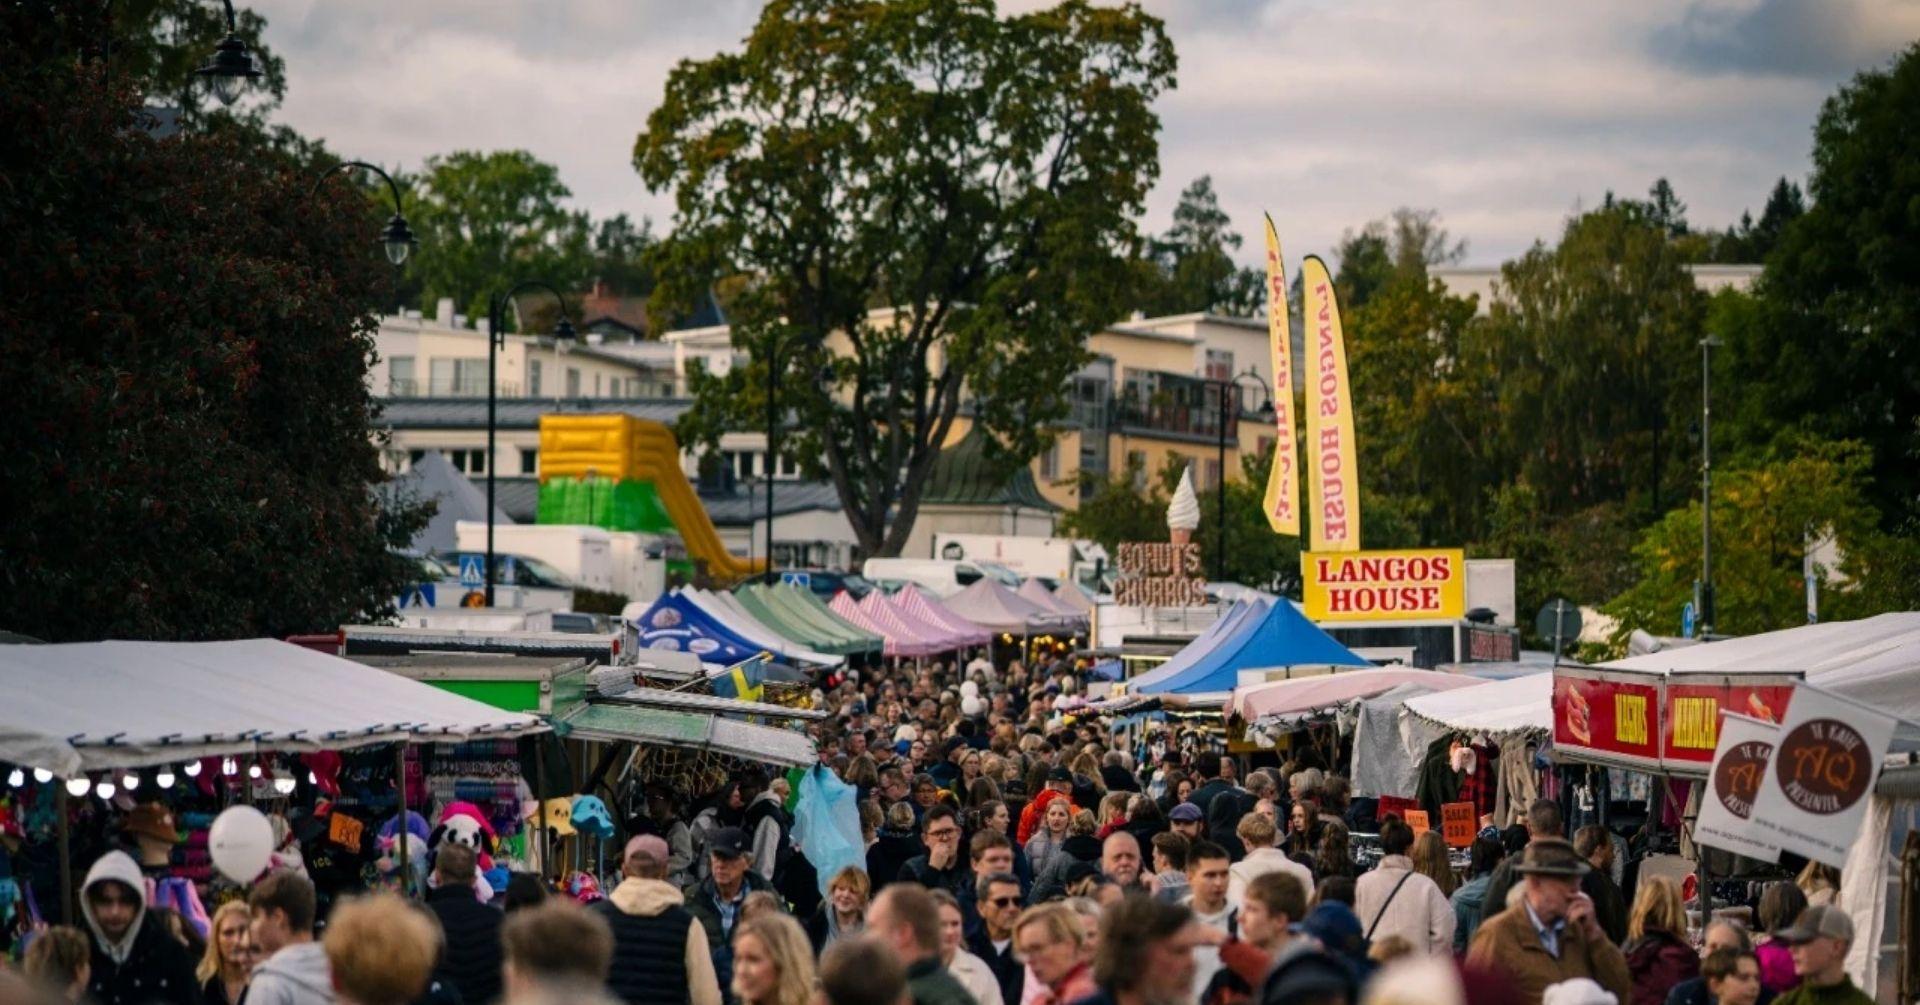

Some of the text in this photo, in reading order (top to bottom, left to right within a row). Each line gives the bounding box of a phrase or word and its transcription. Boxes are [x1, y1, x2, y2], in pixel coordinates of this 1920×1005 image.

[1318, 558, 1450, 582] LANGOS
[1114, 576, 1208, 607] CHURROS
[1330, 587, 1440, 611] HOUSE
[1793, 745, 1856, 791] AQ
